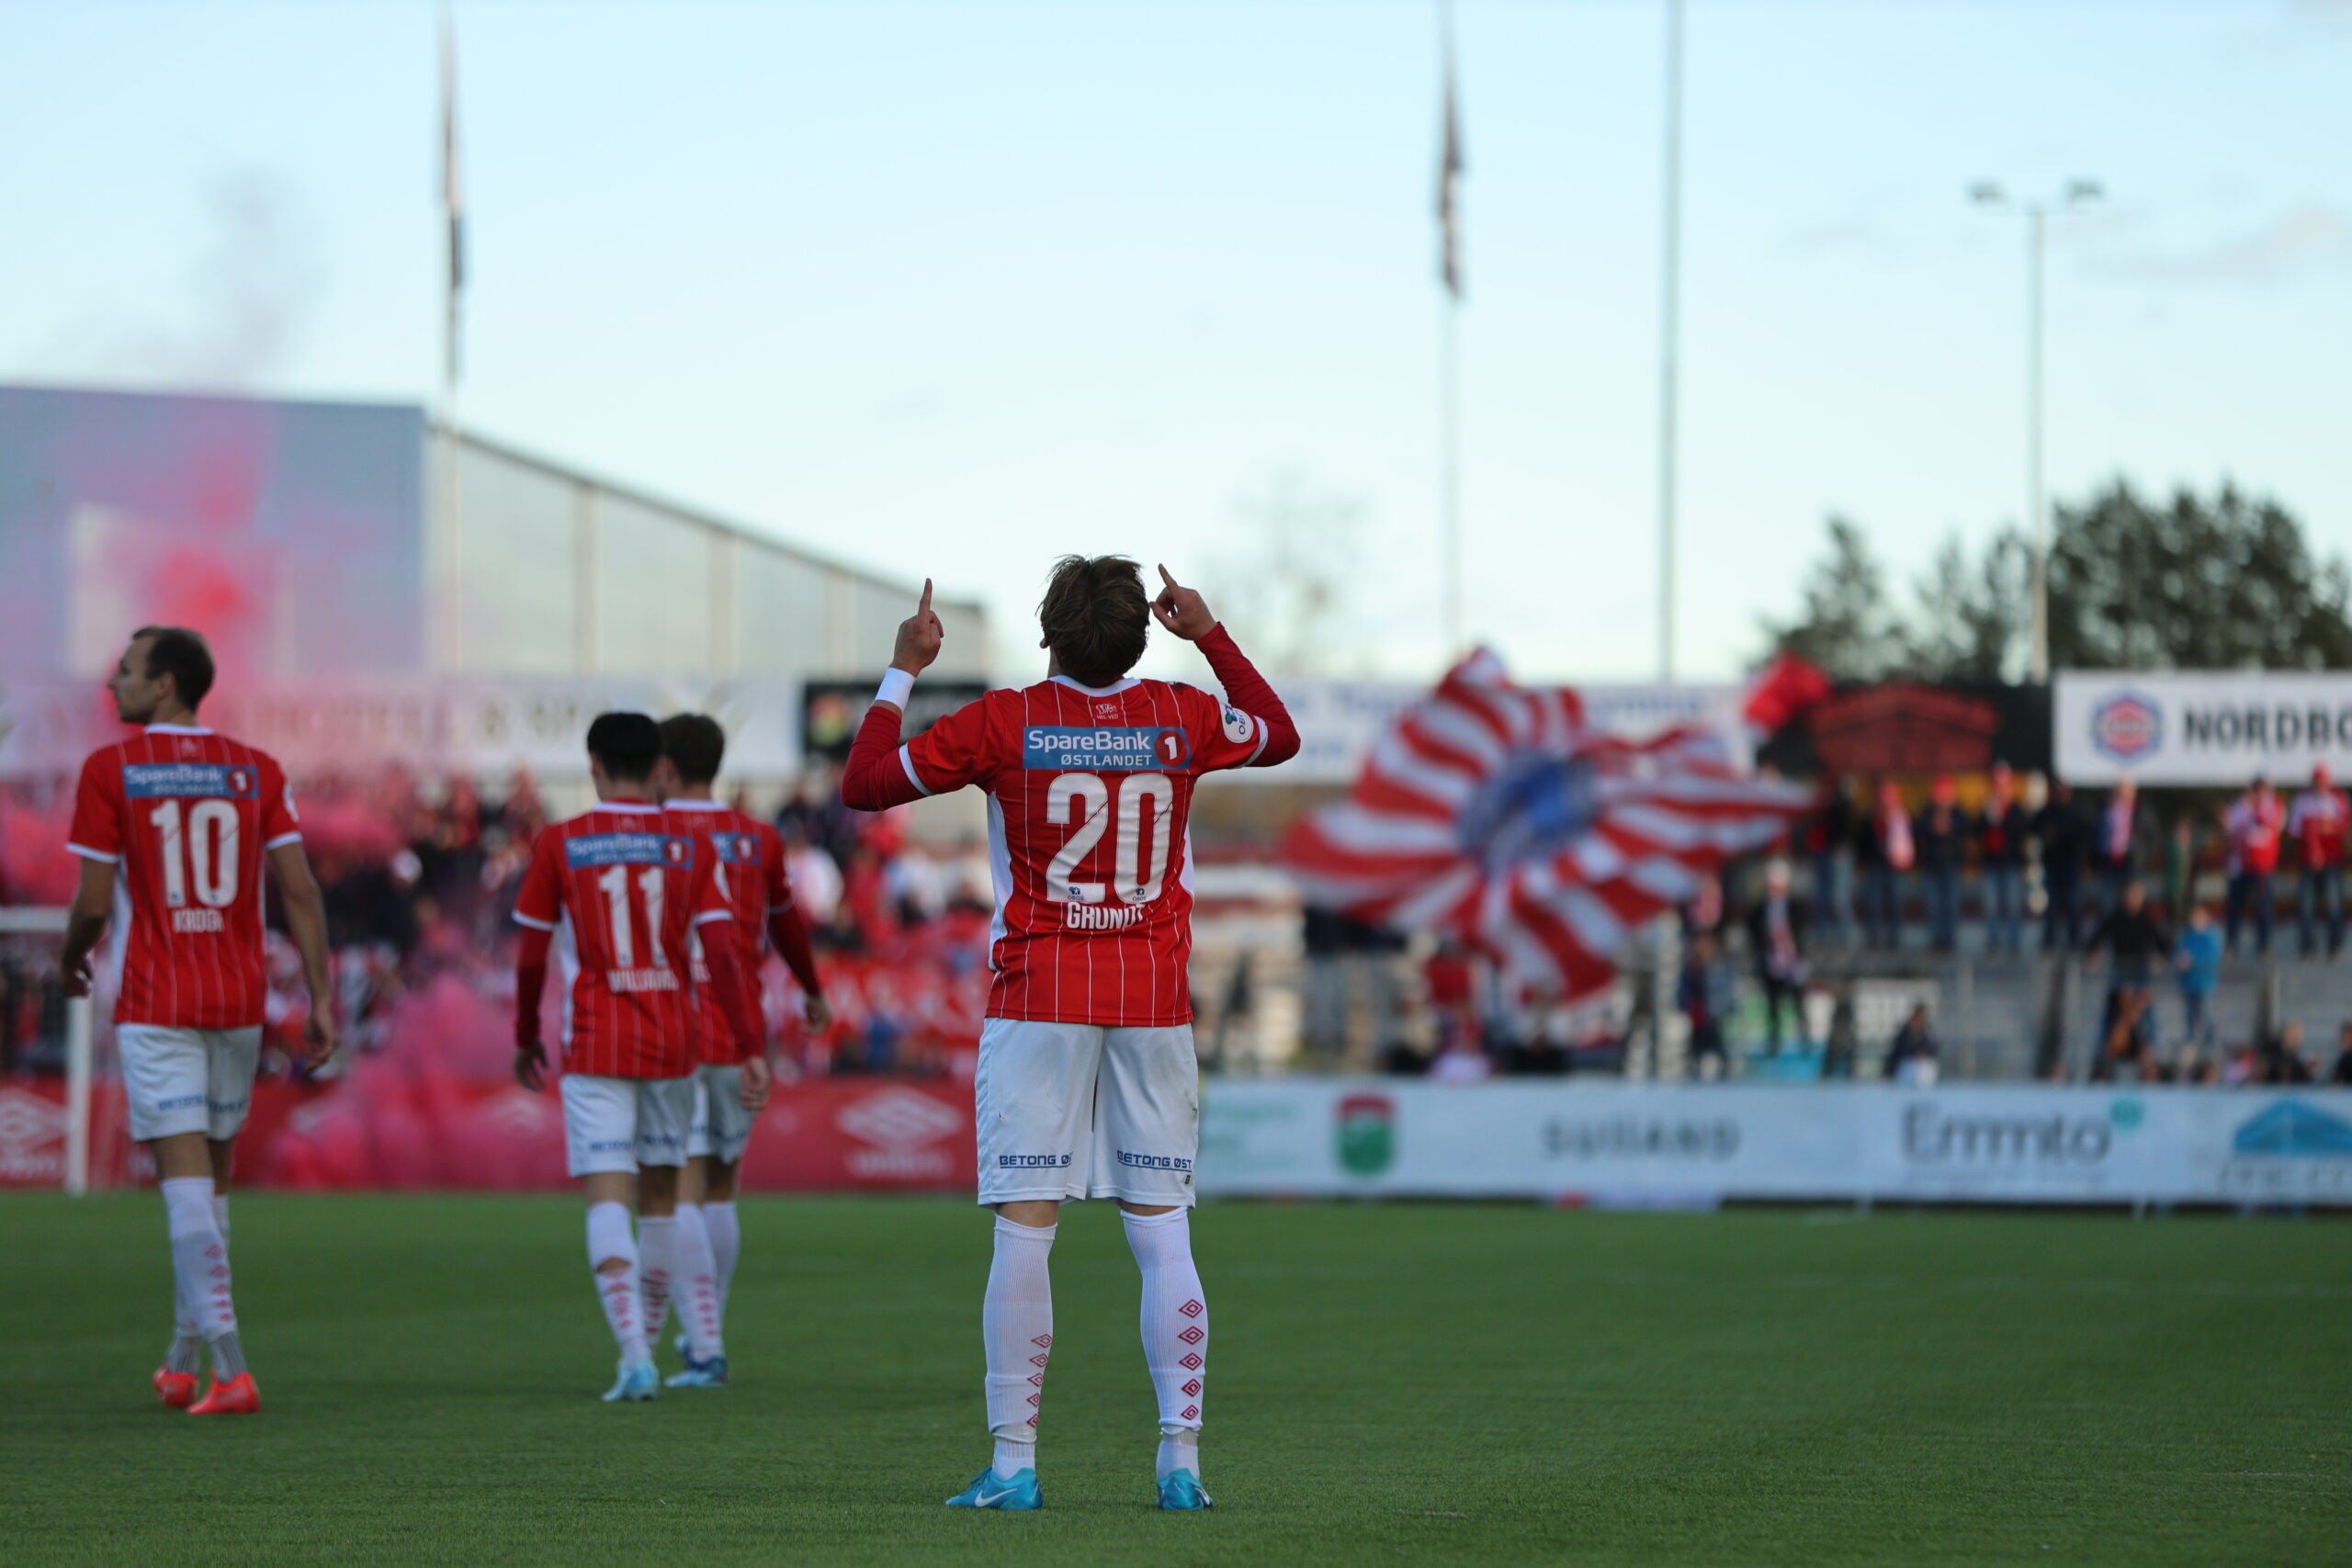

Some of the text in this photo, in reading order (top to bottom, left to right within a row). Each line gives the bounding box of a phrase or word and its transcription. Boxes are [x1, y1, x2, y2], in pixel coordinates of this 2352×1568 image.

[1028, 730, 1178, 760] SpareBank 1
[1061, 754, 1152, 766] ØSTLANDET
[125, 765, 246, 791] SpareBank 1
[1046, 773, 1174, 903] 20
[150, 798, 240, 908] 10
[599, 864, 668, 967] 11
[1067, 901, 1146, 930] GRUNDT
[1000, 1155, 1056, 1165] BETONG
[1117, 1150, 1192, 1169] BETONG ØST
